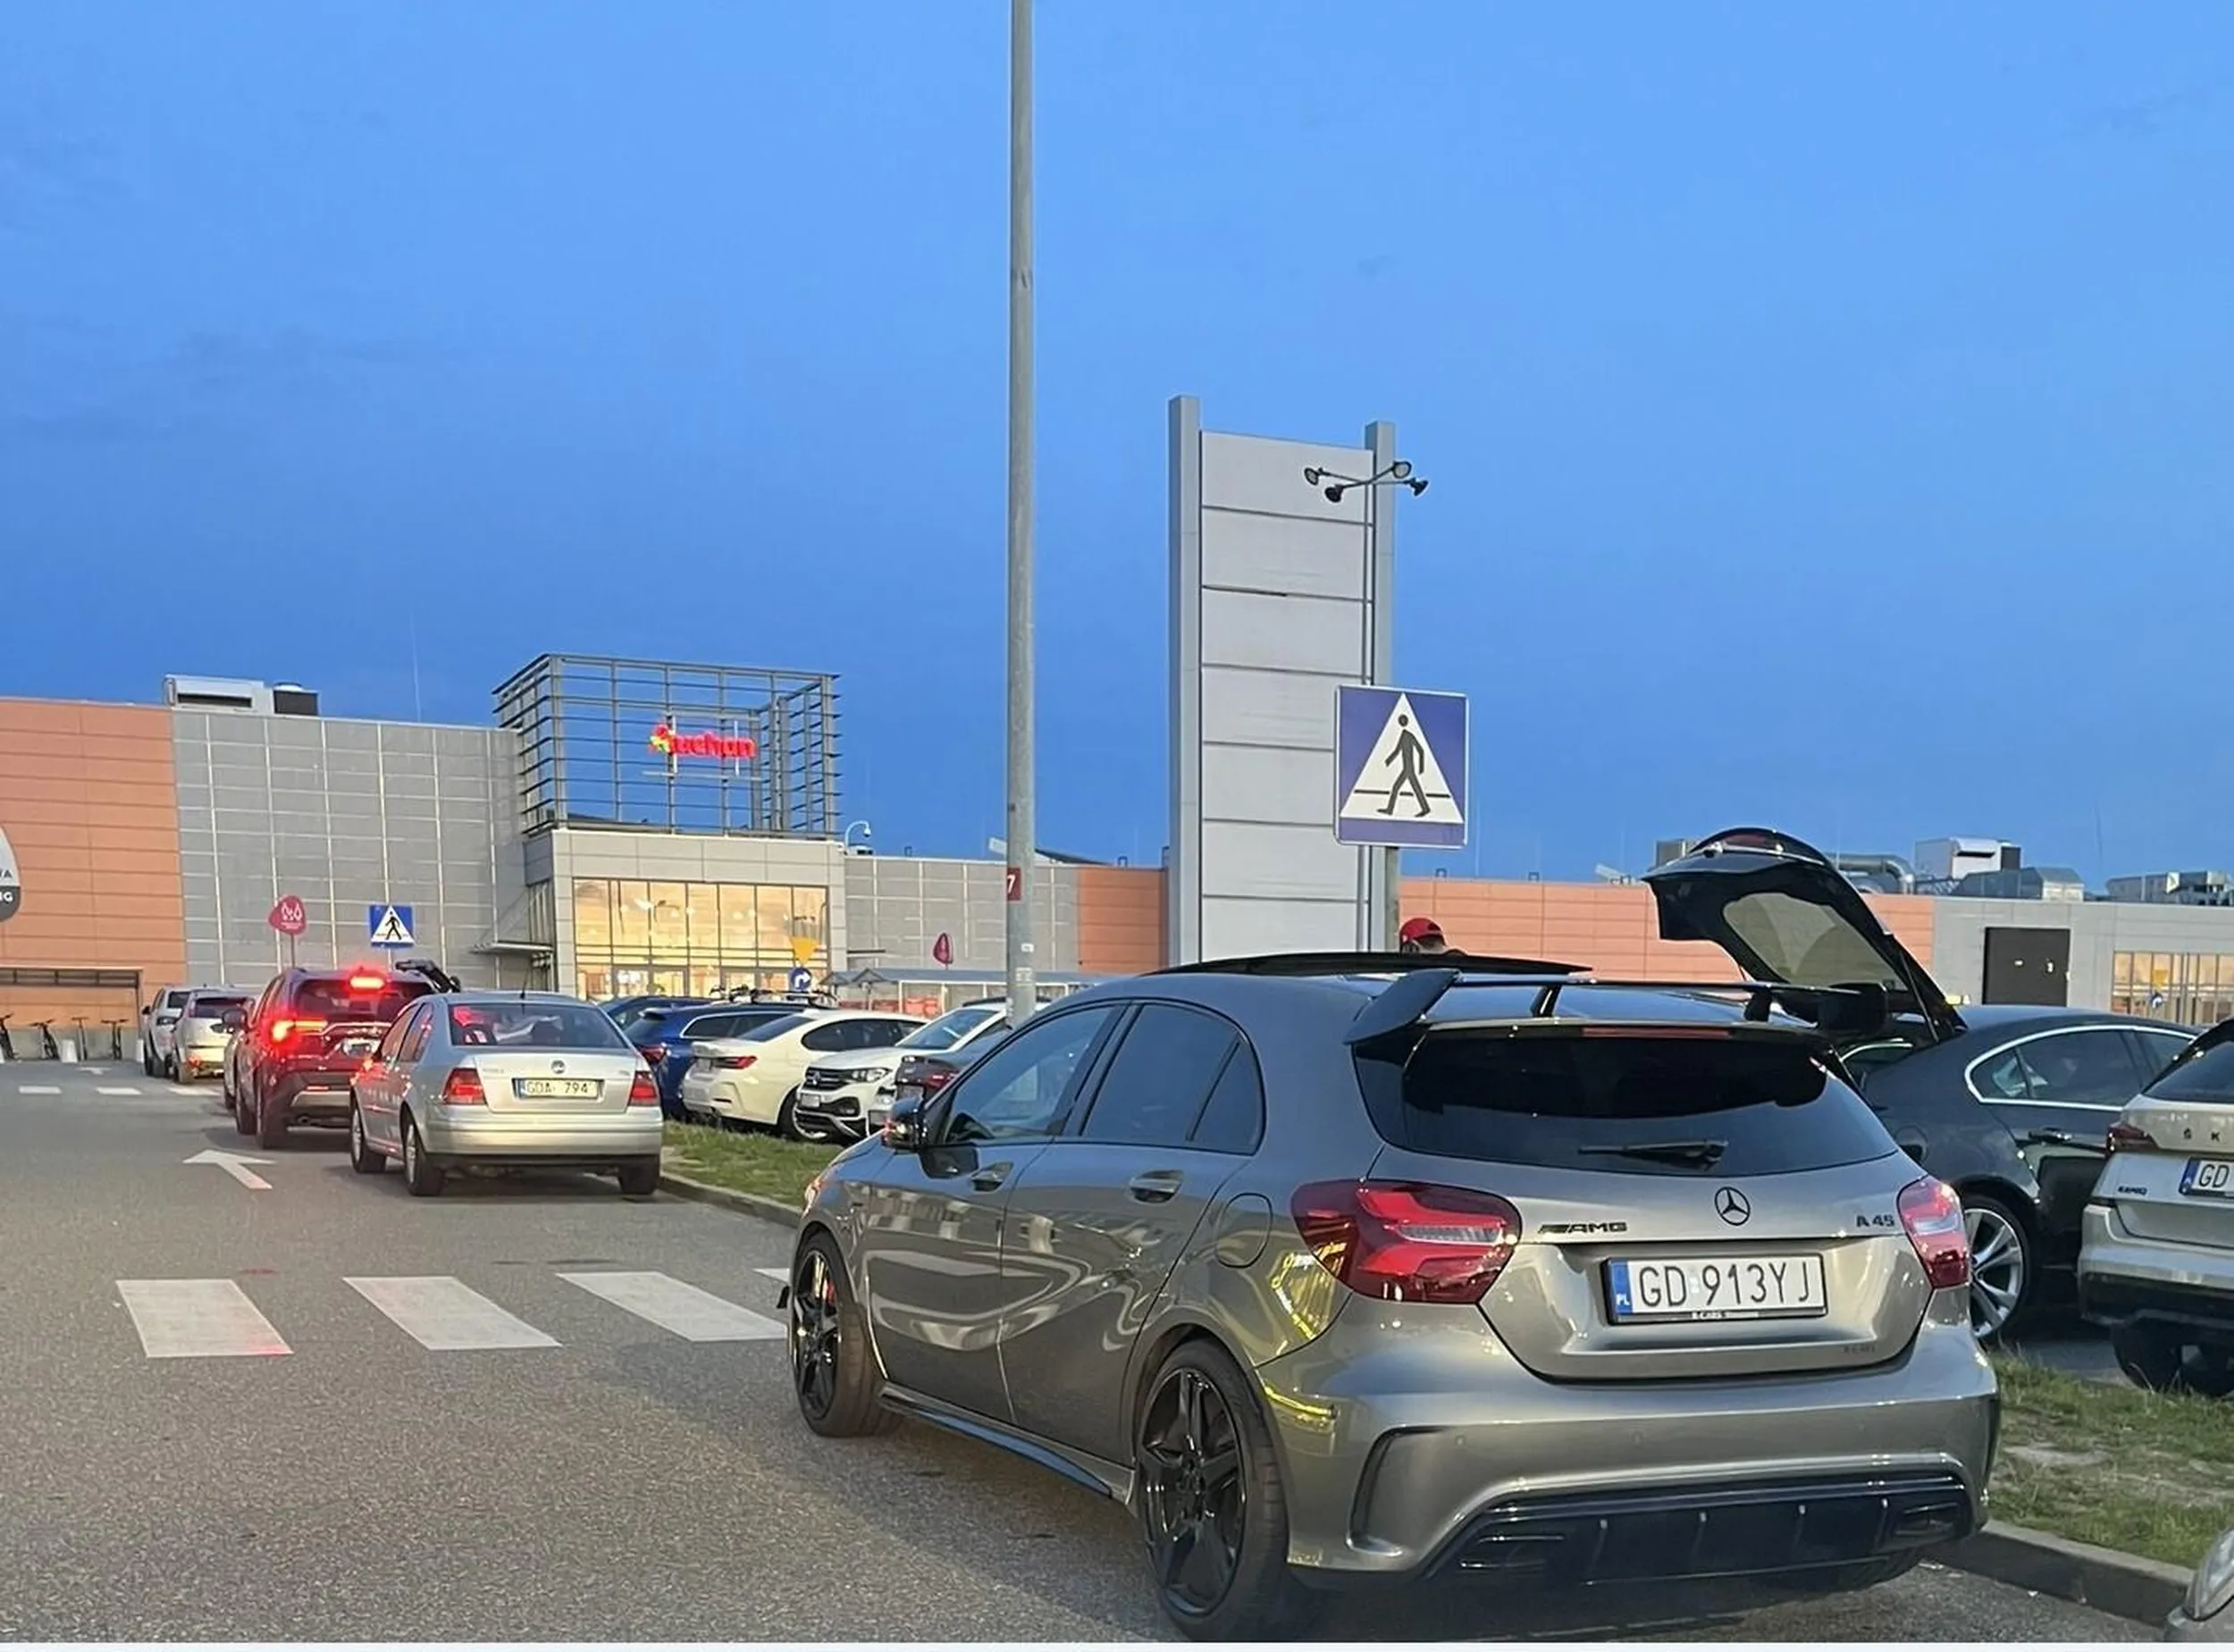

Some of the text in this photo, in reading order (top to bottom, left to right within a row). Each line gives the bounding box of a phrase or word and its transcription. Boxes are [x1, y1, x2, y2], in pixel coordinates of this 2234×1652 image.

[1007, 874, 1016, 893] 7
[2198, 1163, 2230, 1188] GD
[1568, 1221, 1628, 1234] AMG
[1639, 1265, 1687, 1307] GD
